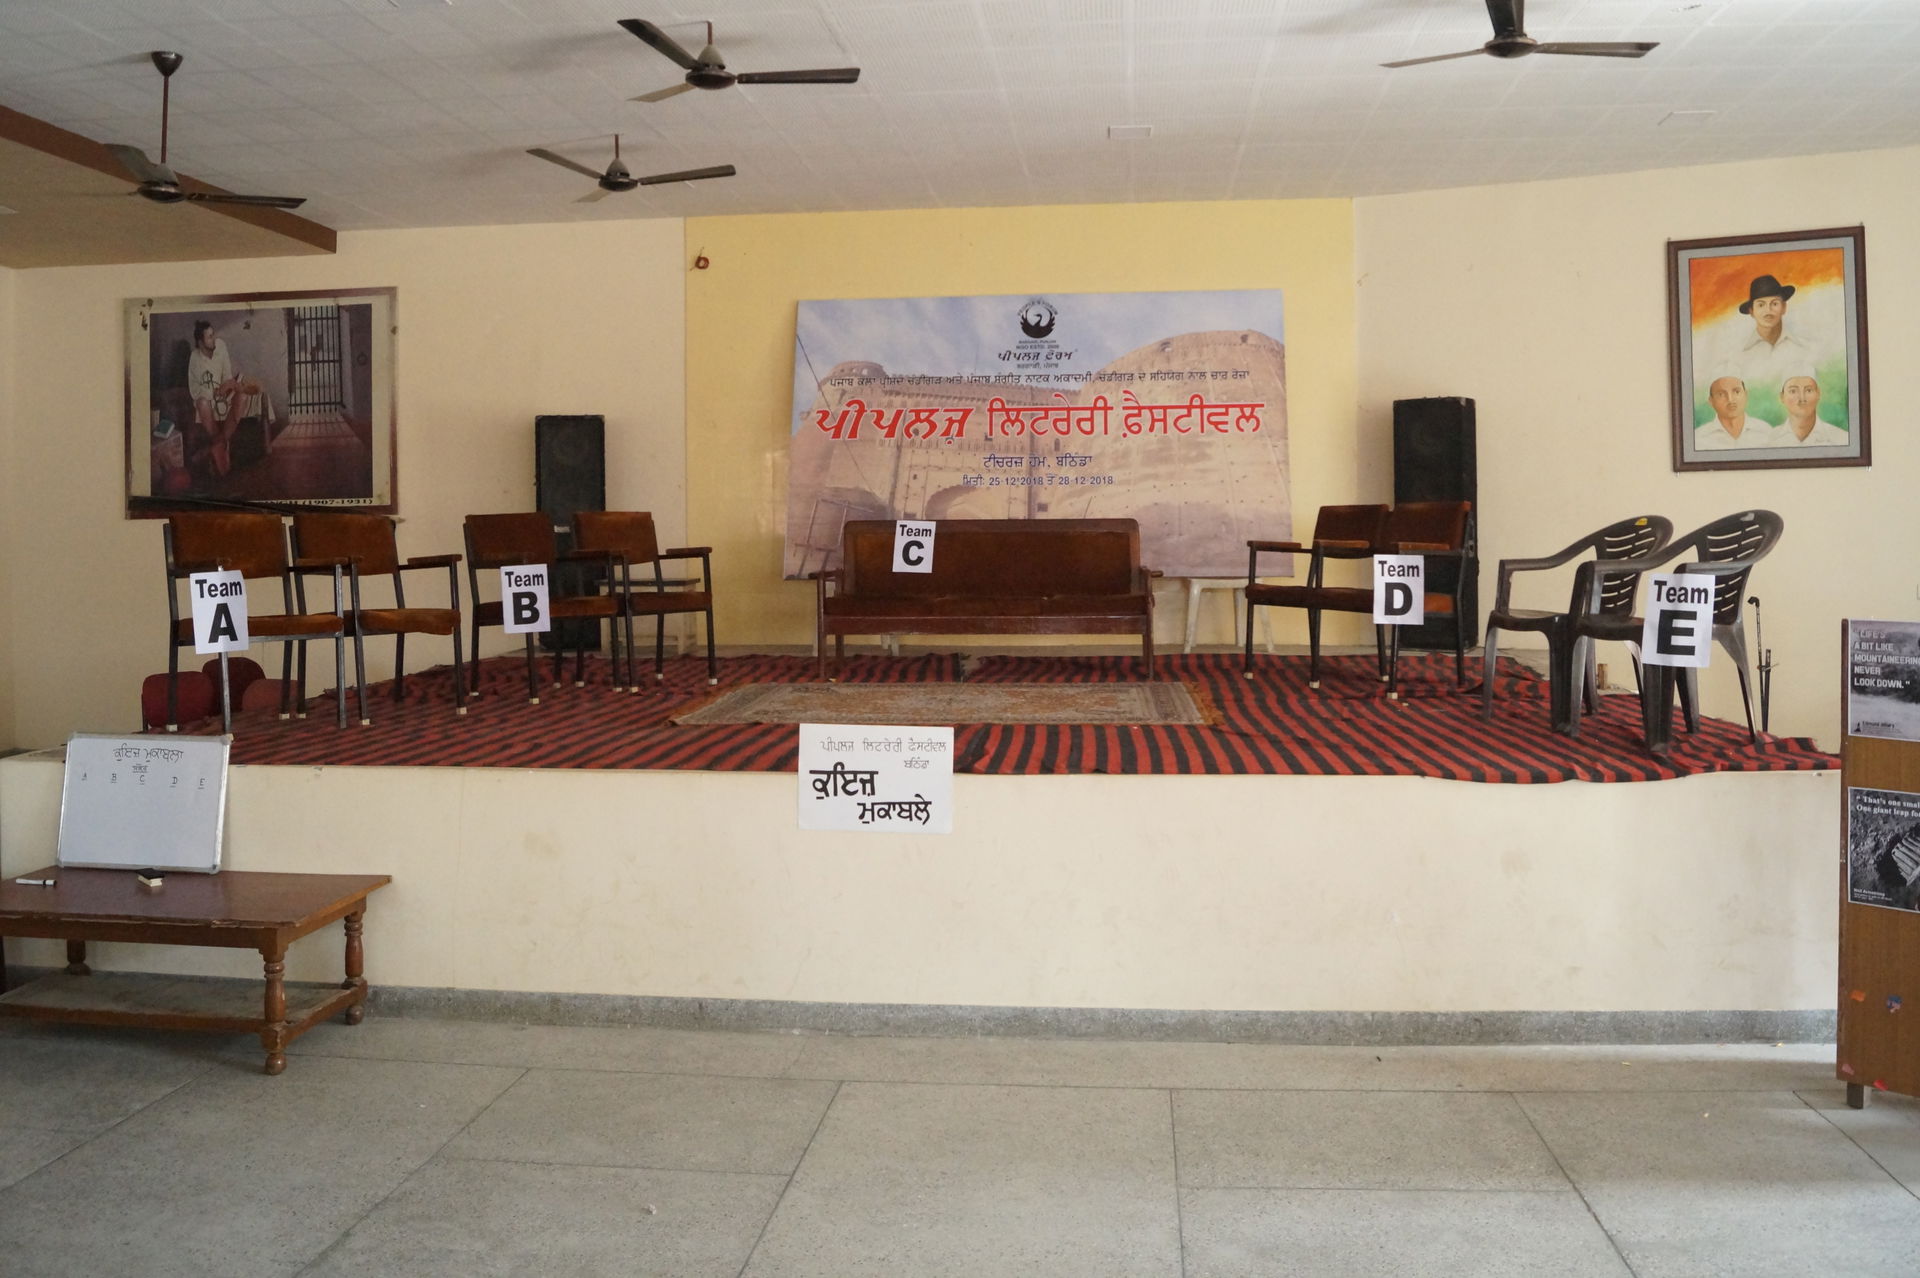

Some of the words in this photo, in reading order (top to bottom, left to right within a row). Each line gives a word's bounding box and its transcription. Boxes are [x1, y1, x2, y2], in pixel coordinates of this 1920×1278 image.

[1025, 374, 1050, 383] ਨਾਟਕ
[1188, 370, 1207, 380] ਨਾਲ
[1210, 371, 1228, 380] ਚਾਰ
[815, 400, 974, 444] ਪੀਪਲਜ਼
[986, 393, 1114, 437] ਲਿਟਰੇਰੀ
[1122, 389, 1266, 439] ਫ਼ੈਸਟੀਵਲ
[899, 524, 932, 537] Team
[902, 540, 924, 566] C
[504, 571, 544, 588] Team
[1378, 560, 1420, 577] Team
[195, 579, 242, 598] Team
[1384, 582, 1413, 616] D
[1654, 580, 1709, 604] Team
[512, 592, 540, 625] B
[208, 603, 239, 643] A
[1656, 609, 1697, 656] E
[1854, 641, 1860, 650] A
[1861, 642, 1874, 651] BIT
[1875, 642, 1894, 651] LIKE
[1854, 665, 1880, 675] NEVER
[1854, 677, 1876, 687] LOOK
[809, 761, 879, 800] ਕੁਇਜ਼
[857, 793, 932, 825] ਮੁਕਾਬਲੇ
